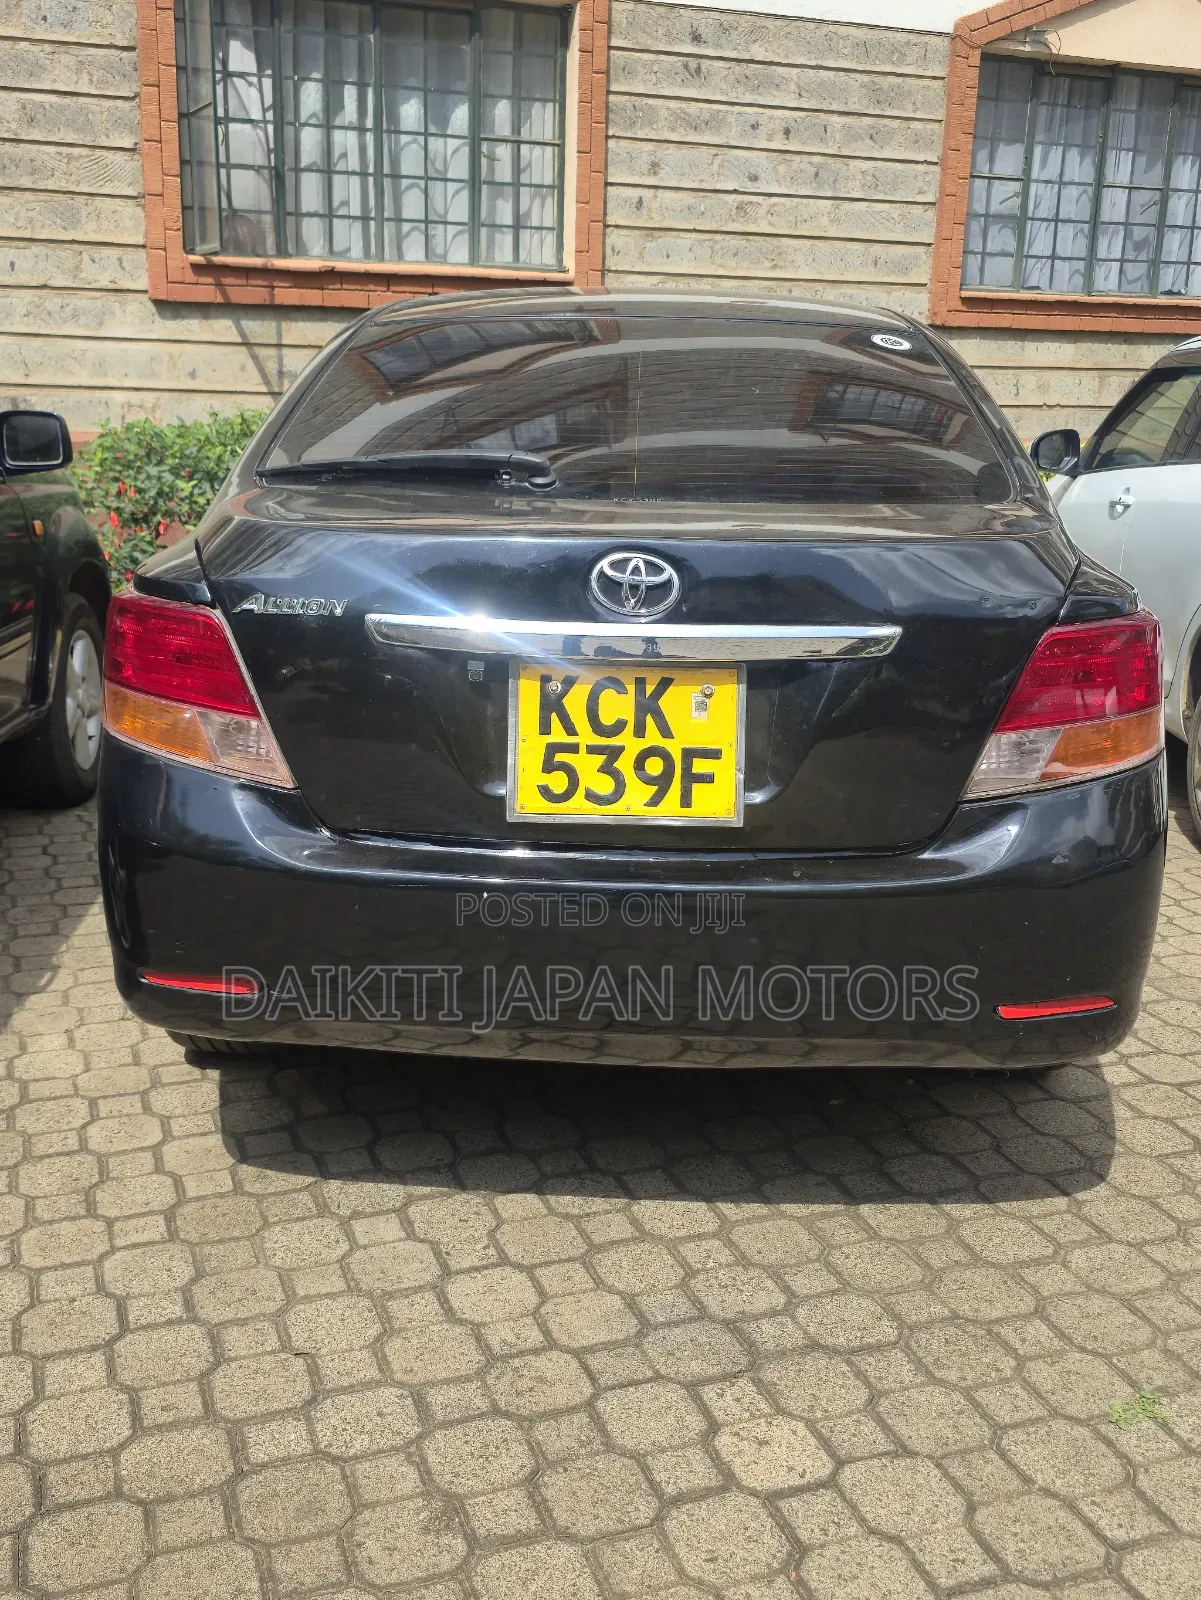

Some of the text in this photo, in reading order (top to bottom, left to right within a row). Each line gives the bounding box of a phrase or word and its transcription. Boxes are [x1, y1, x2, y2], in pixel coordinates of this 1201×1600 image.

[231, 592, 348, 617] ALLION
[538, 674, 675, 739] KCK
[536, 742, 722, 808] 539F
